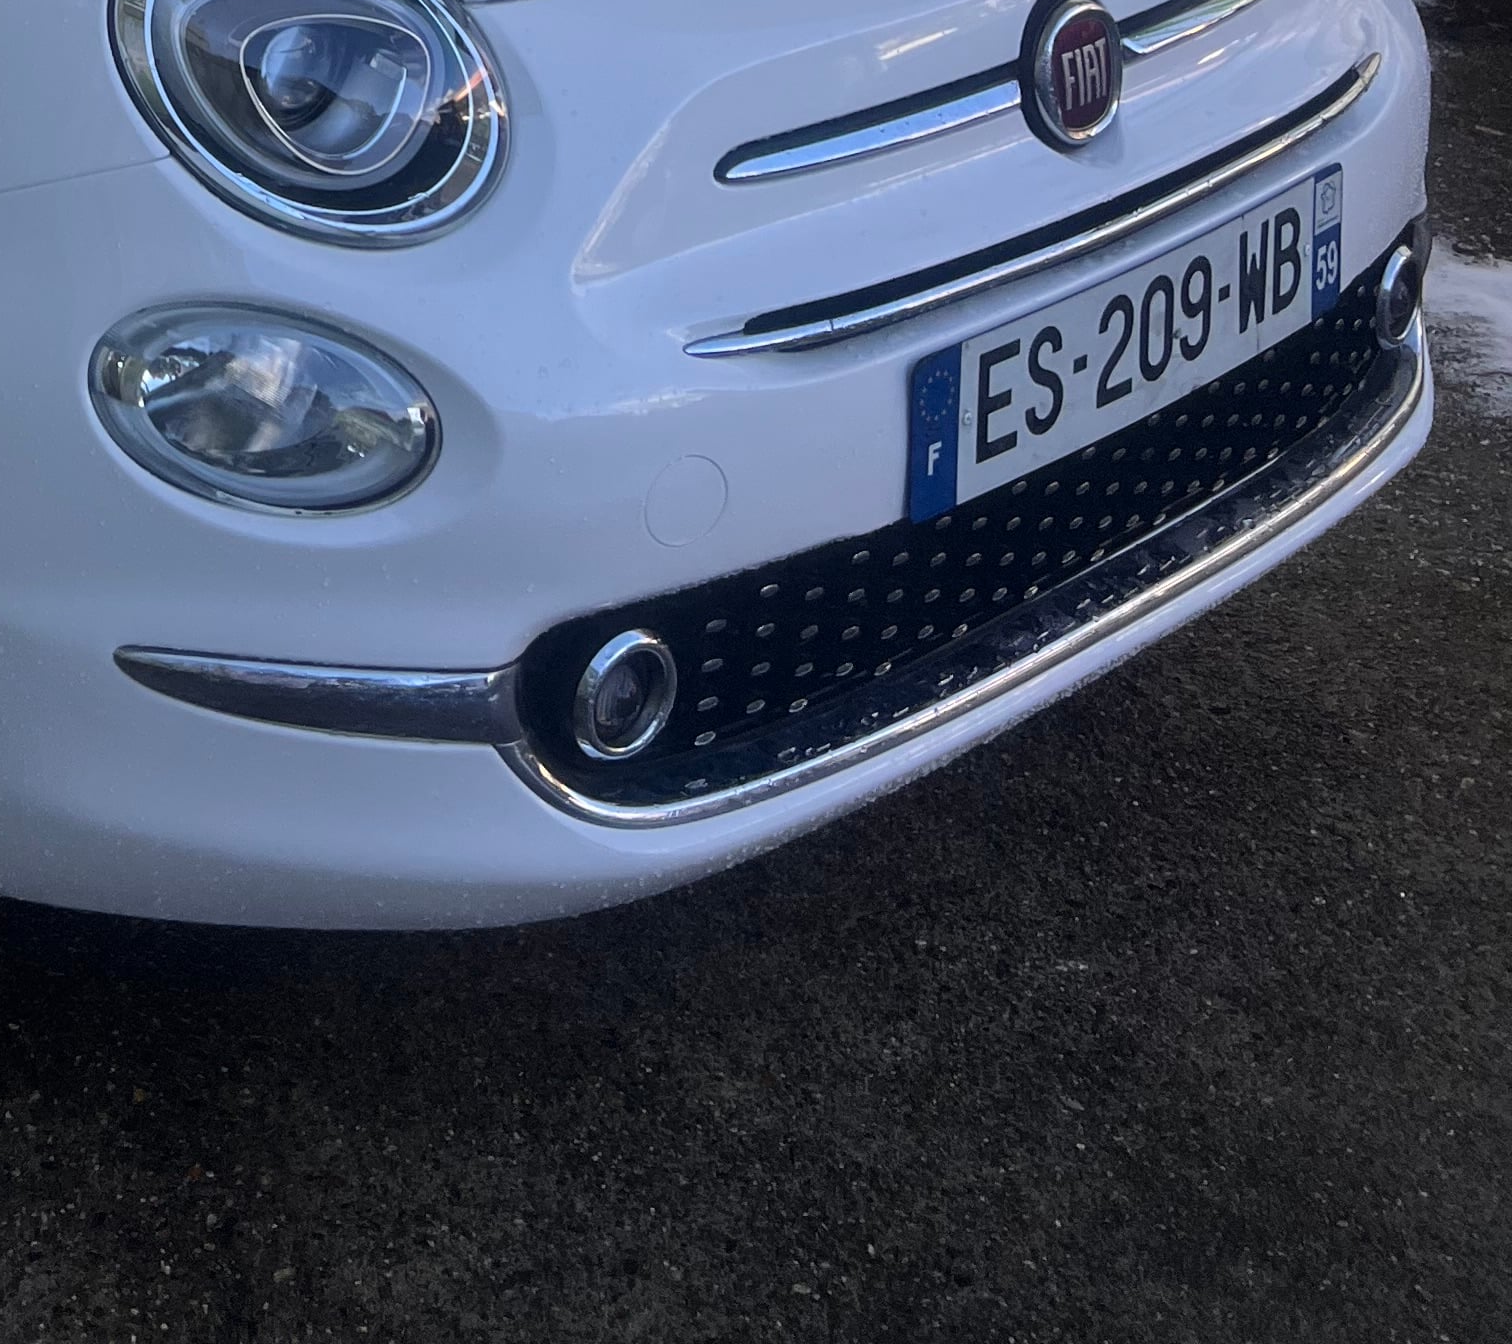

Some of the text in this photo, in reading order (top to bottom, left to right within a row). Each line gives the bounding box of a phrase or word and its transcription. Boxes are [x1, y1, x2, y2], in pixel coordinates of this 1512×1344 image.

[1060, 36, 1108, 111] FIAT
[1316, 240, 1338, 290] 59
[926, 206, 1302, 477] F ES-209-WB
